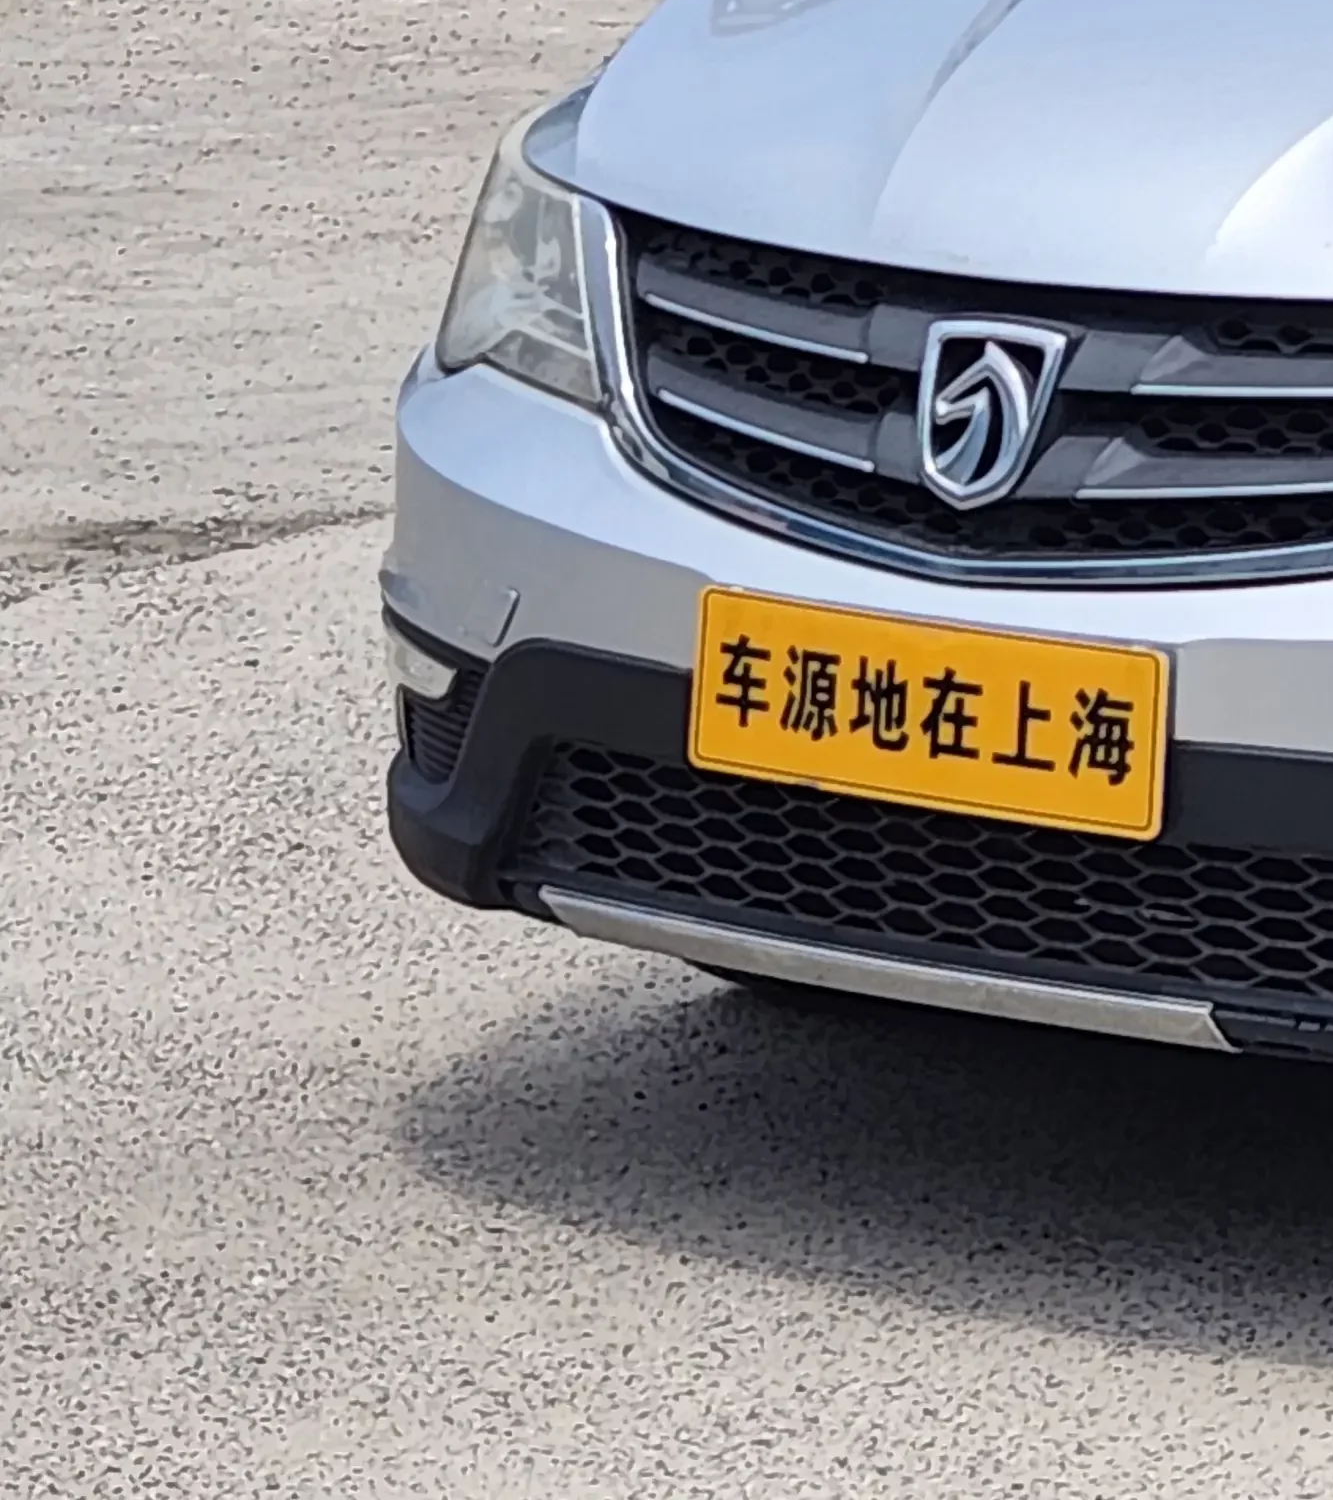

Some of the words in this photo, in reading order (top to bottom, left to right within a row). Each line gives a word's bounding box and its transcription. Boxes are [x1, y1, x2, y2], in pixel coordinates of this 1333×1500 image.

[715, 634, 1135, 785] 车源地在上海
